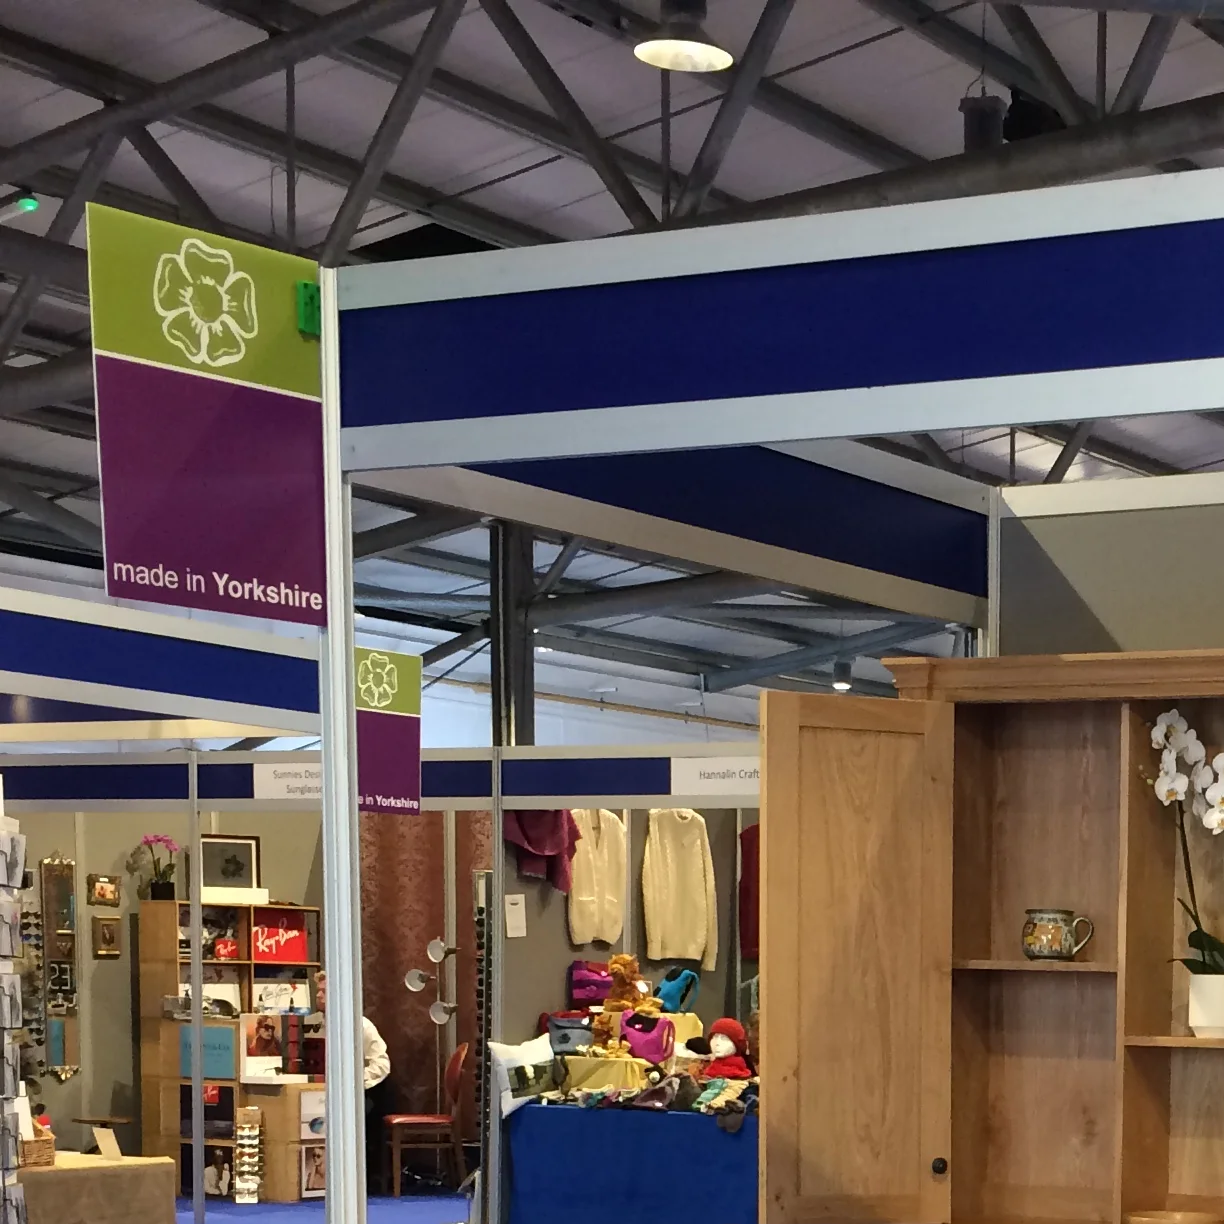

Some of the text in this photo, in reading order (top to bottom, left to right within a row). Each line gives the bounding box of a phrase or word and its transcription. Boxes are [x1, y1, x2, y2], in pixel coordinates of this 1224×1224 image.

[113, 562, 323, 611] made in Yorkshire
[365, 794, 374, 805] in
[375, 795, 419, 810] Yorkshire
